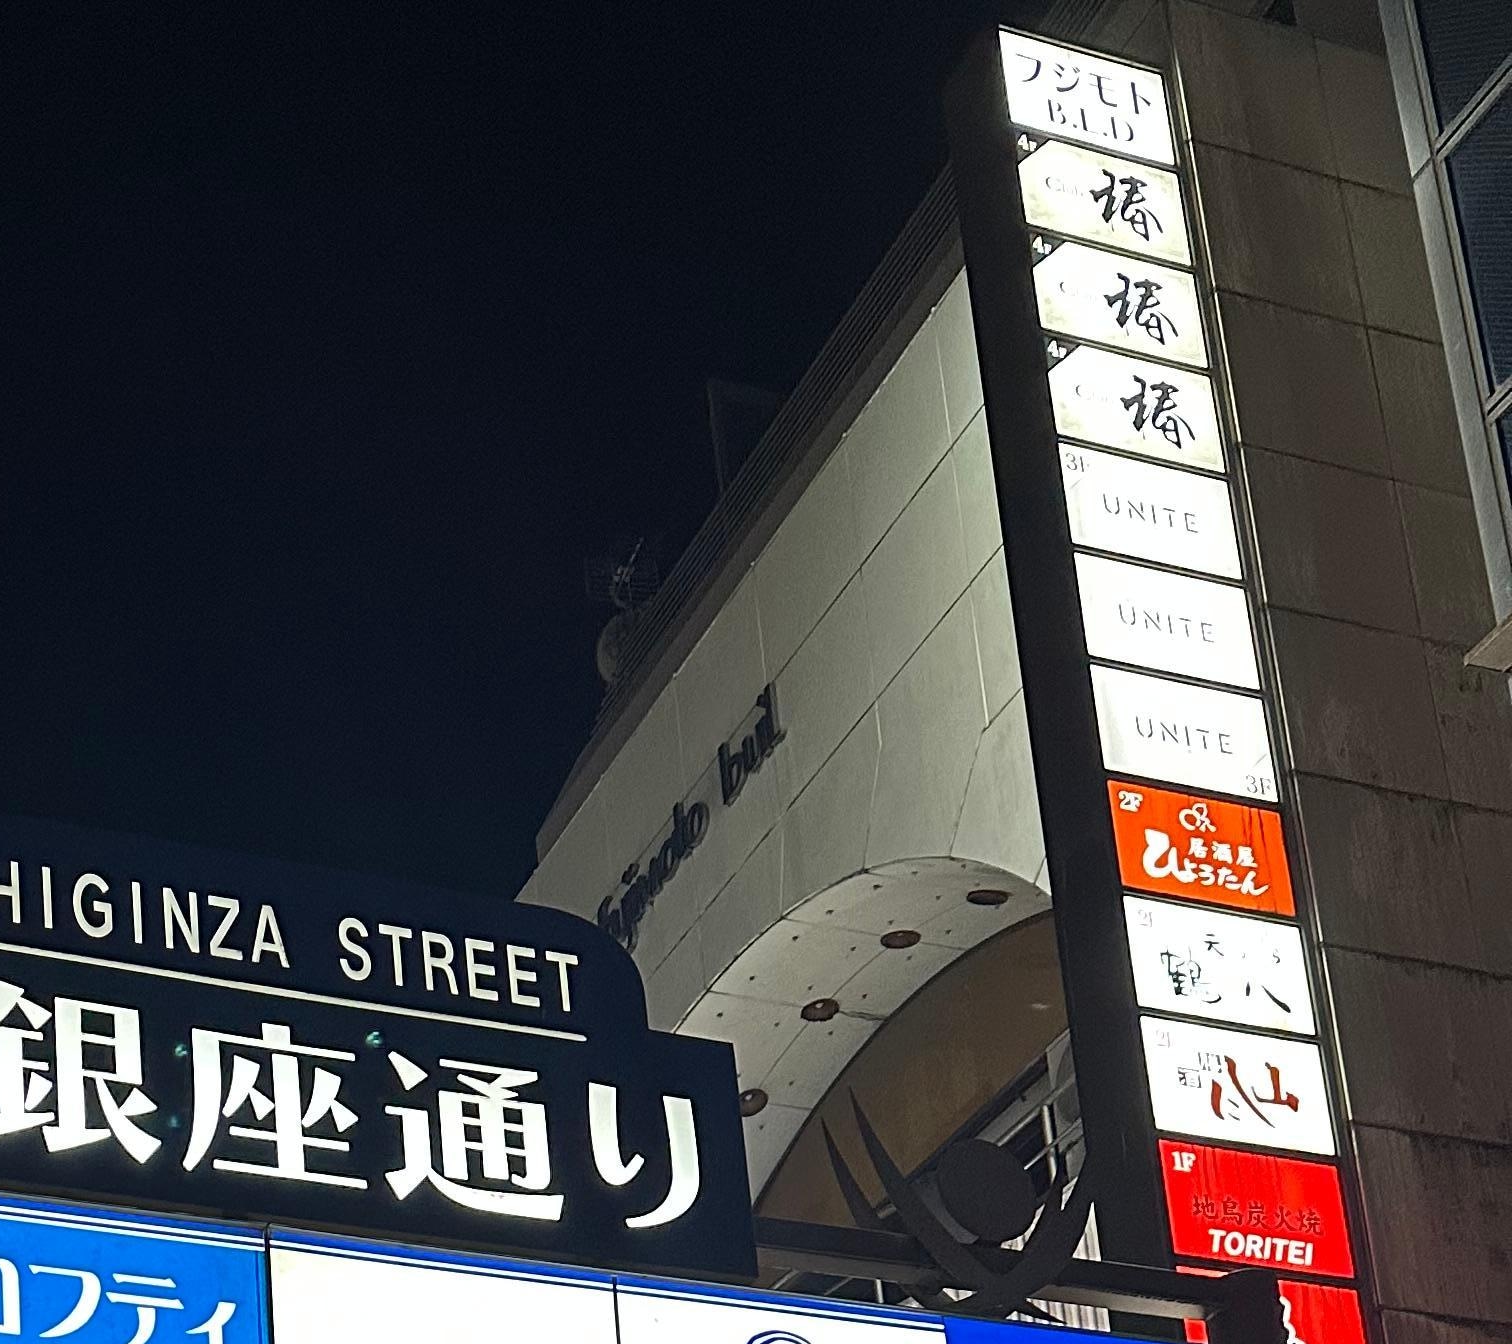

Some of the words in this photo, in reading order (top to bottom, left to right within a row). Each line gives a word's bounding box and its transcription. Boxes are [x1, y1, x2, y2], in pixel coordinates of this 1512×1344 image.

[1015, 52, 1152, 115] フジモト
[1103, 493, 1199, 533] UNITE
[1119, 603, 1215, 643] UNITE
[1136, 715, 1233, 755] UNITE
[1188, 837, 1258, 868] 居酒屋
[337, 916, 580, 1013] STREET
[1172, 1151, 1196, 1173] 1F
[1208, 1228, 1314, 1267] TORITEI
